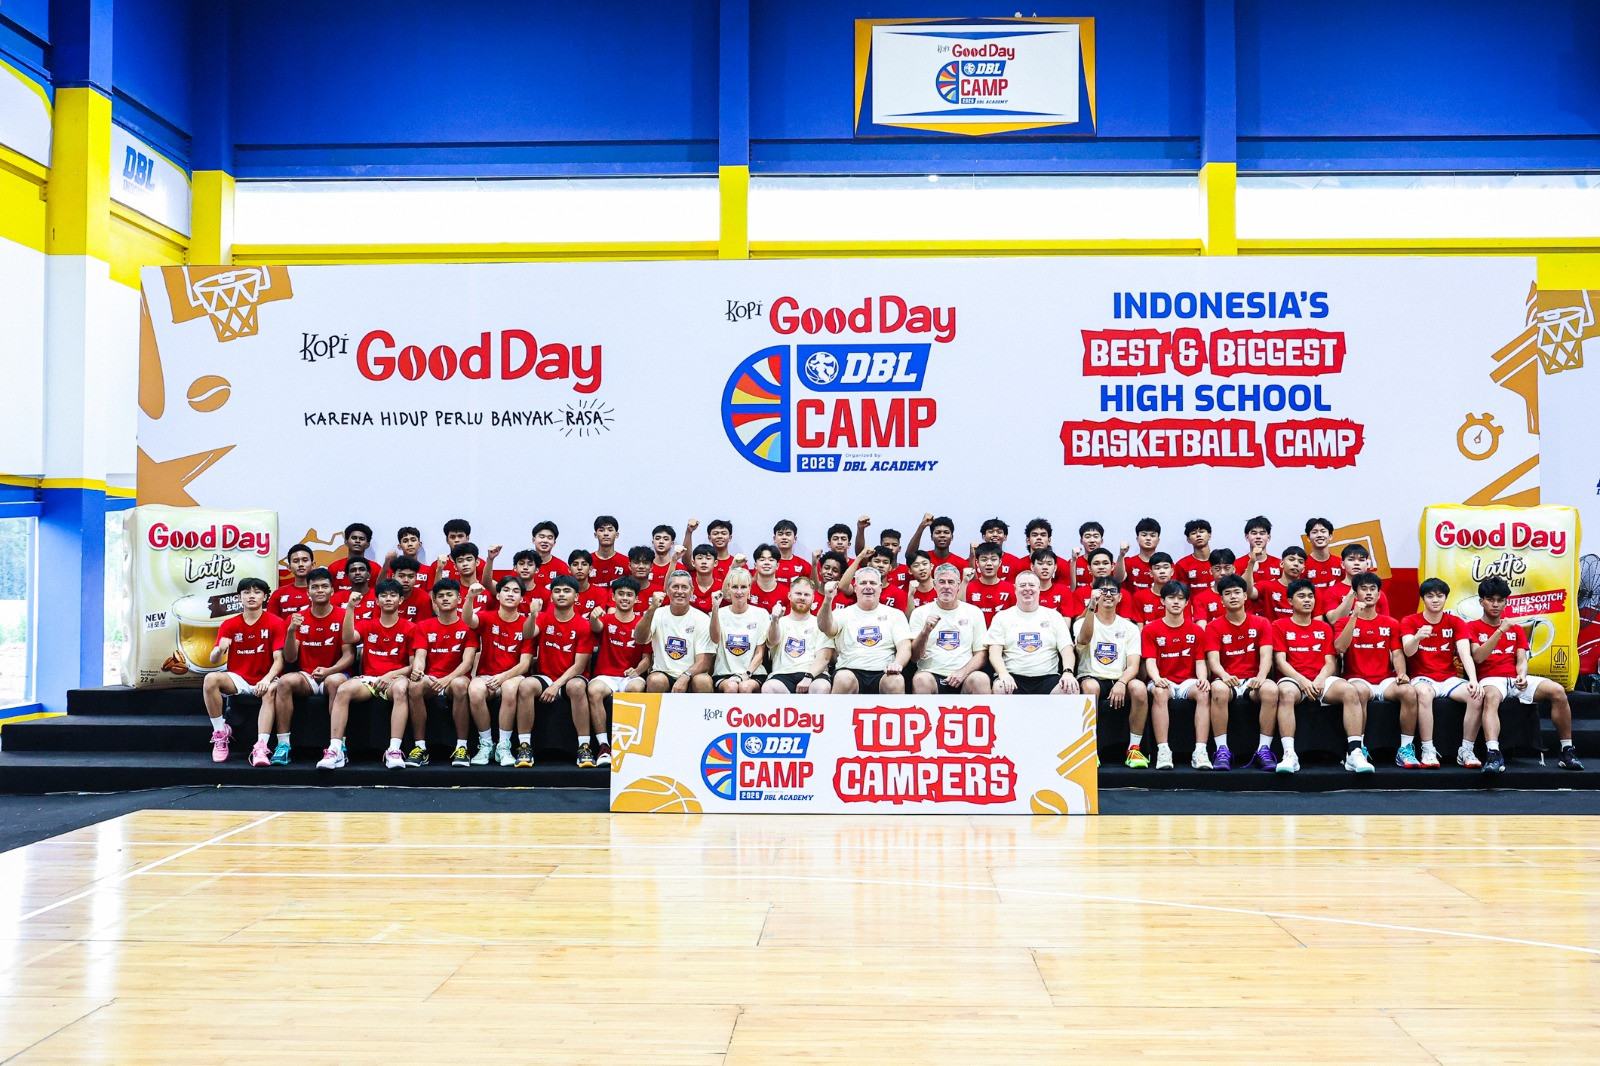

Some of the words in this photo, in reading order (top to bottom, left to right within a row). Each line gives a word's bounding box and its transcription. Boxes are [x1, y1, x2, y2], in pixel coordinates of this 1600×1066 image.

[952, 44, 987, 58] Good
[989, 44, 1015, 60] Day
[975, 63, 1001, 75] DBL
[961, 79, 1008, 96] CAMP
[123, 145, 155, 192] DBL
[1113, 291, 1330, 319] INDONESIA'S
[725, 300, 763, 322] Kopi
[769, 296, 872, 335] Good
[879, 295, 956, 343] Day
[1090, 338, 1163, 367] BEST
[1178, 338, 1199, 367] &
[299, 332, 349, 362] Kopi
[356, 329, 491, 381] Good
[500, 329, 602, 394] Day
[840, 352, 919, 383] DBL
[1100, 384, 1184, 412] HIGH
[1194, 384, 1332, 412] SCHOOL
[304, 411, 374, 427] KARENA
[380, 410, 428, 426] HIDUP
[435, 411, 484, 426] PERLU
[491, 410, 554, 427] BANYAK
[565, 410, 604, 426] RASA
[796, 398, 937, 448] CAMP
[1071, 428, 1255, 458] BASKETBALL
[1275, 428, 1357, 458] CAMP
[801, 456, 835, 470] 2026
[842, 461, 867, 472] DBL
[870, 460, 939, 472] ACADEMY
[148, 522, 217, 549] Good
[221, 524, 271, 556] Day
[1434, 520, 1506, 548] Good
[1511, 522, 1567, 556] Day
[184, 553, 235, 583] Latte
[1471, 553, 1527, 583] Latte
[219, 595, 240, 605] ORIG
[885, 596, 895, 605] 72
[999, 592, 1009, 601] 77
[1506, 592, 1564, 607] UTTERSCOTCH
[145, 611, 167, 623] NEW
[260, 629, 269, 639] 14
[329, 622, 340, 632] 43
[455, 630, 467, 640] 87
[569, 630, 576, 640] 3
[1248, 628, 1257, 638] 99
[513, 631, 523, 641] 78
[1185, 633, 1196, 644] 93
[704, 708, 723, 721] Kopi
[727, 707, 780, 728] Good
[784, 707, 824, 733] Day
[858, 713, 928, 746] TOP
[943, 712, 990, 746] 50
[763, 737, 804, 754] DBL
[740, 761, 814, 788] CAMP
[839, 759, 1015, 797] CAMPERS
